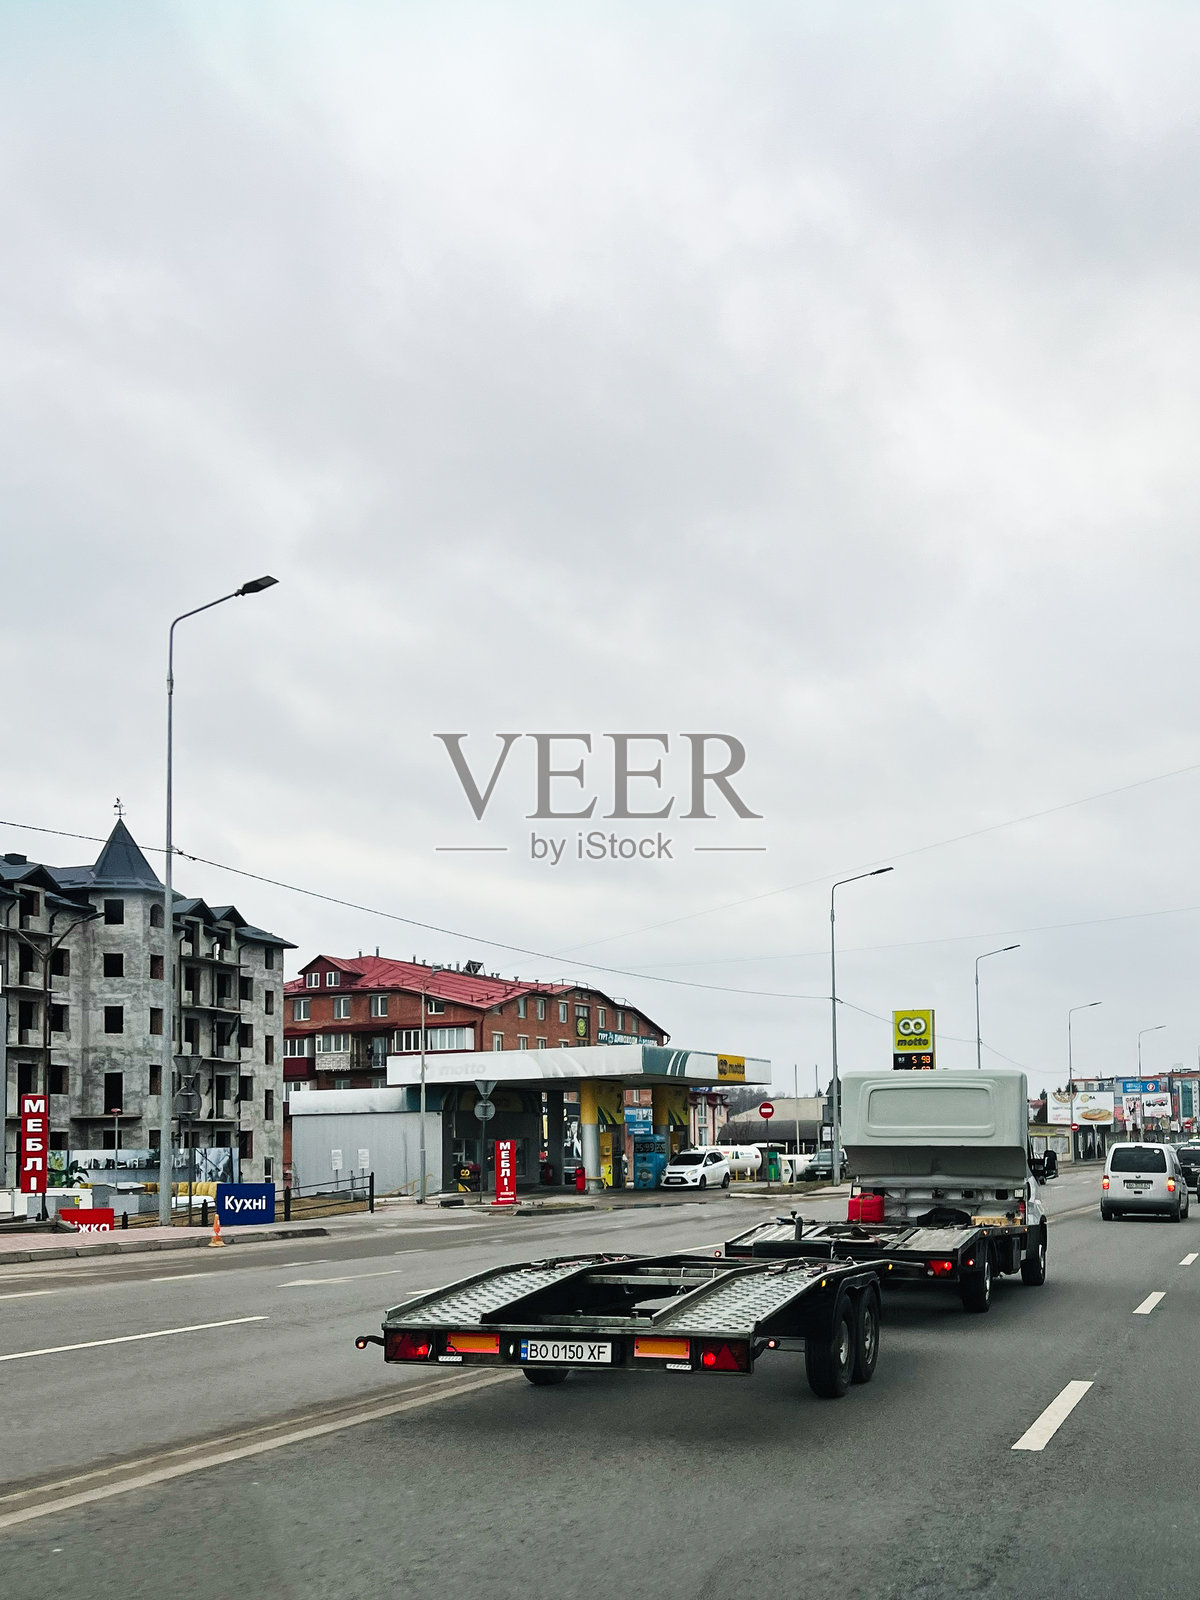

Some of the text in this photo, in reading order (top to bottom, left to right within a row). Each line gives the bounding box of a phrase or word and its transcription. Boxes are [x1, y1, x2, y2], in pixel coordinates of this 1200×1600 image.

[897, 1037, 929, 1047] motto
[616, 1093, 622, 1114] 2
[23, 1099, 45, 1191] МЕБЛІ
[499, 1141, 511, 1186] МЕБЛІ
[225, 1195, 266, 1213] Кухні
[67, 1220, 110, 1233] жка
[529, 1343, 548, 1359] BO
[552, 1344, 584, 1360] 0150
[587, 1345, 607, 1360] XF
